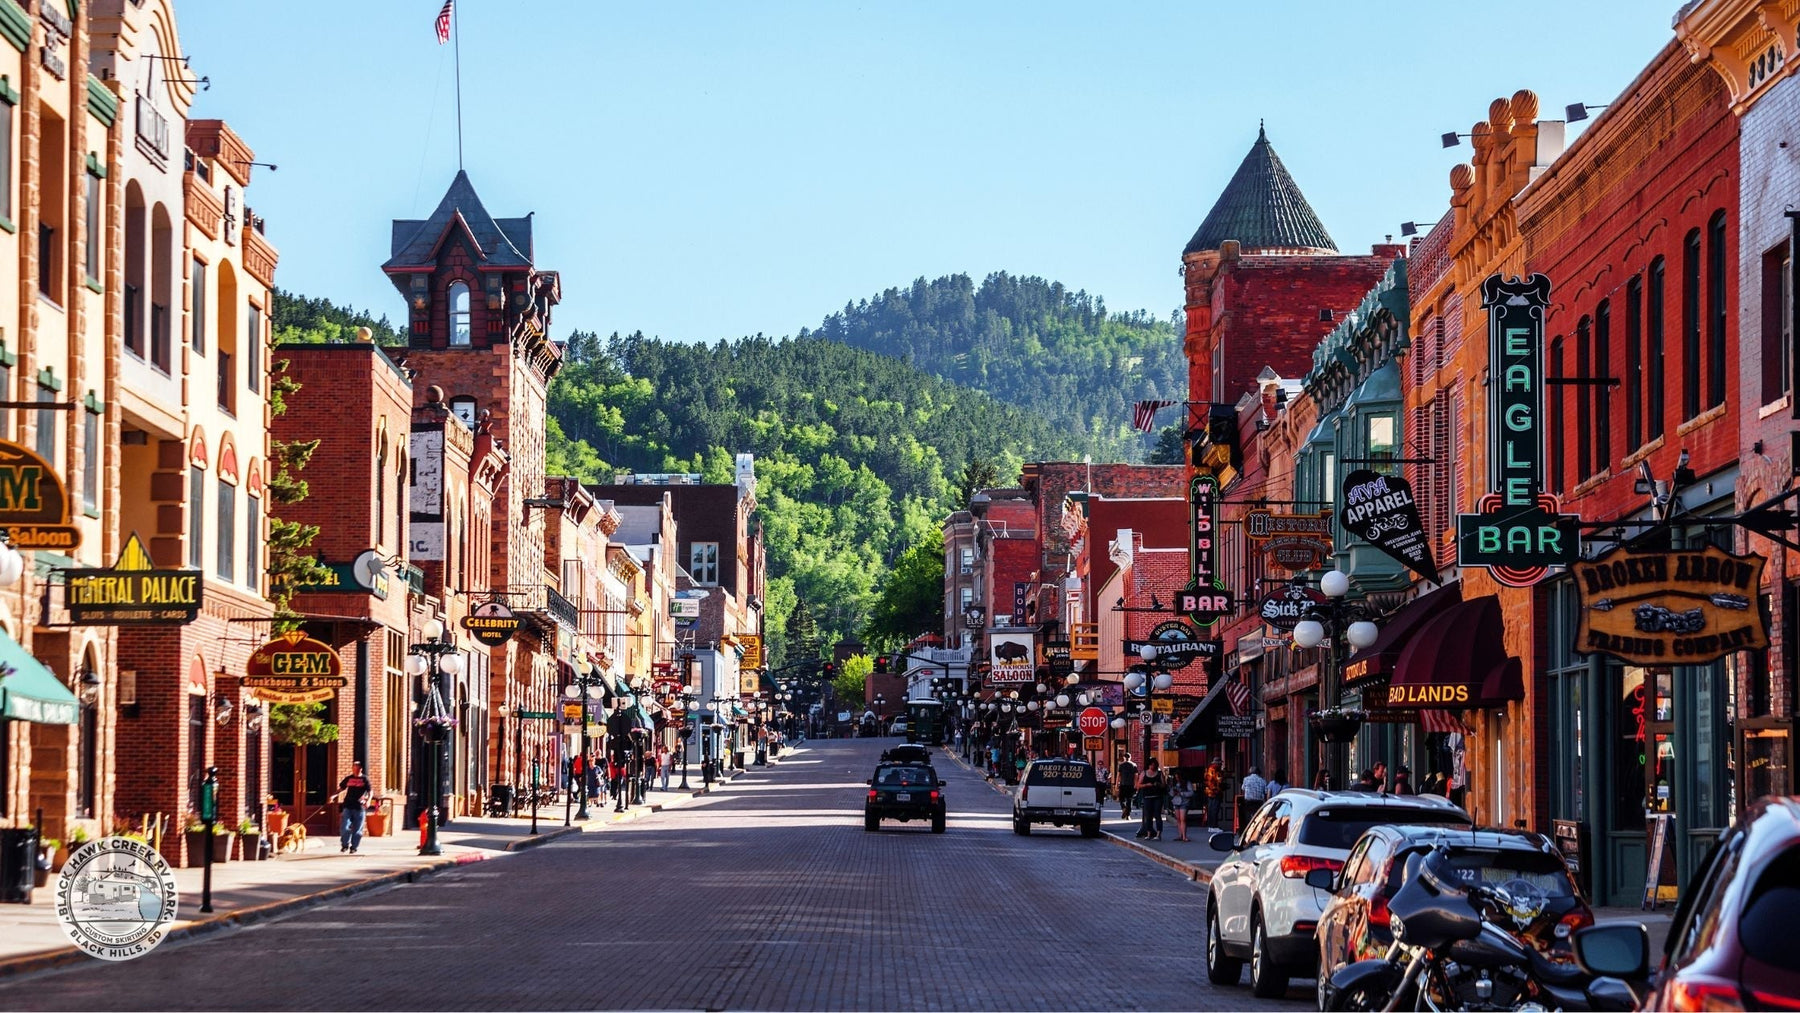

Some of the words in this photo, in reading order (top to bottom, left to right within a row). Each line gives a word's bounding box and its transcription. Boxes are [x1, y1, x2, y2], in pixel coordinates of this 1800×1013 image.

[1506, 327, 1531, 506] EAGLE
[1348, 476, 1390, 505] AVA
[1198, 484, 1211, 532] WILD
[1347, 490, 1412, 524] APPAREL
[8, 527, 72, 544] Saloon
[1478, 526, 1563, 554] BAR
[1198, 539, 1211, 586] BILL
[1582, 556, 1667, 595] BROKEN
[1674, 556, 1754, 589] ARROW
[72, 577, 134, 604] MINERAL
[142, 577, 196, 603] PALACE
[1183, 596, 1228, 611] BAR
[1262, 600, 1298, 618] Sick
[82, 611, 104, 619] SLOTS
[113, 611, 152, 619] ROULETTE
[161, 610, 187, 619] CARDS
[466, 618, 518, 628] CELEBRITY
[1155, 623, 1178, 636] OYSTER
[1180, 625, 1191, 636] BAY
[1588, 629, 1664, 656] TRADING
[1673, 626, 1753, 656] COMPANY
[272, 652, 331, 674] GEM
[244, 678, 296, 686] Steakhouse
[312, 678, 343, 686] Saloon
[993, 670, 1032, 680] SALOON
[1389, 687, 1405, 703] BAD
[1408, 686, 1468, 702] LANDS
[1081, 717, 1105, 727] STOP
